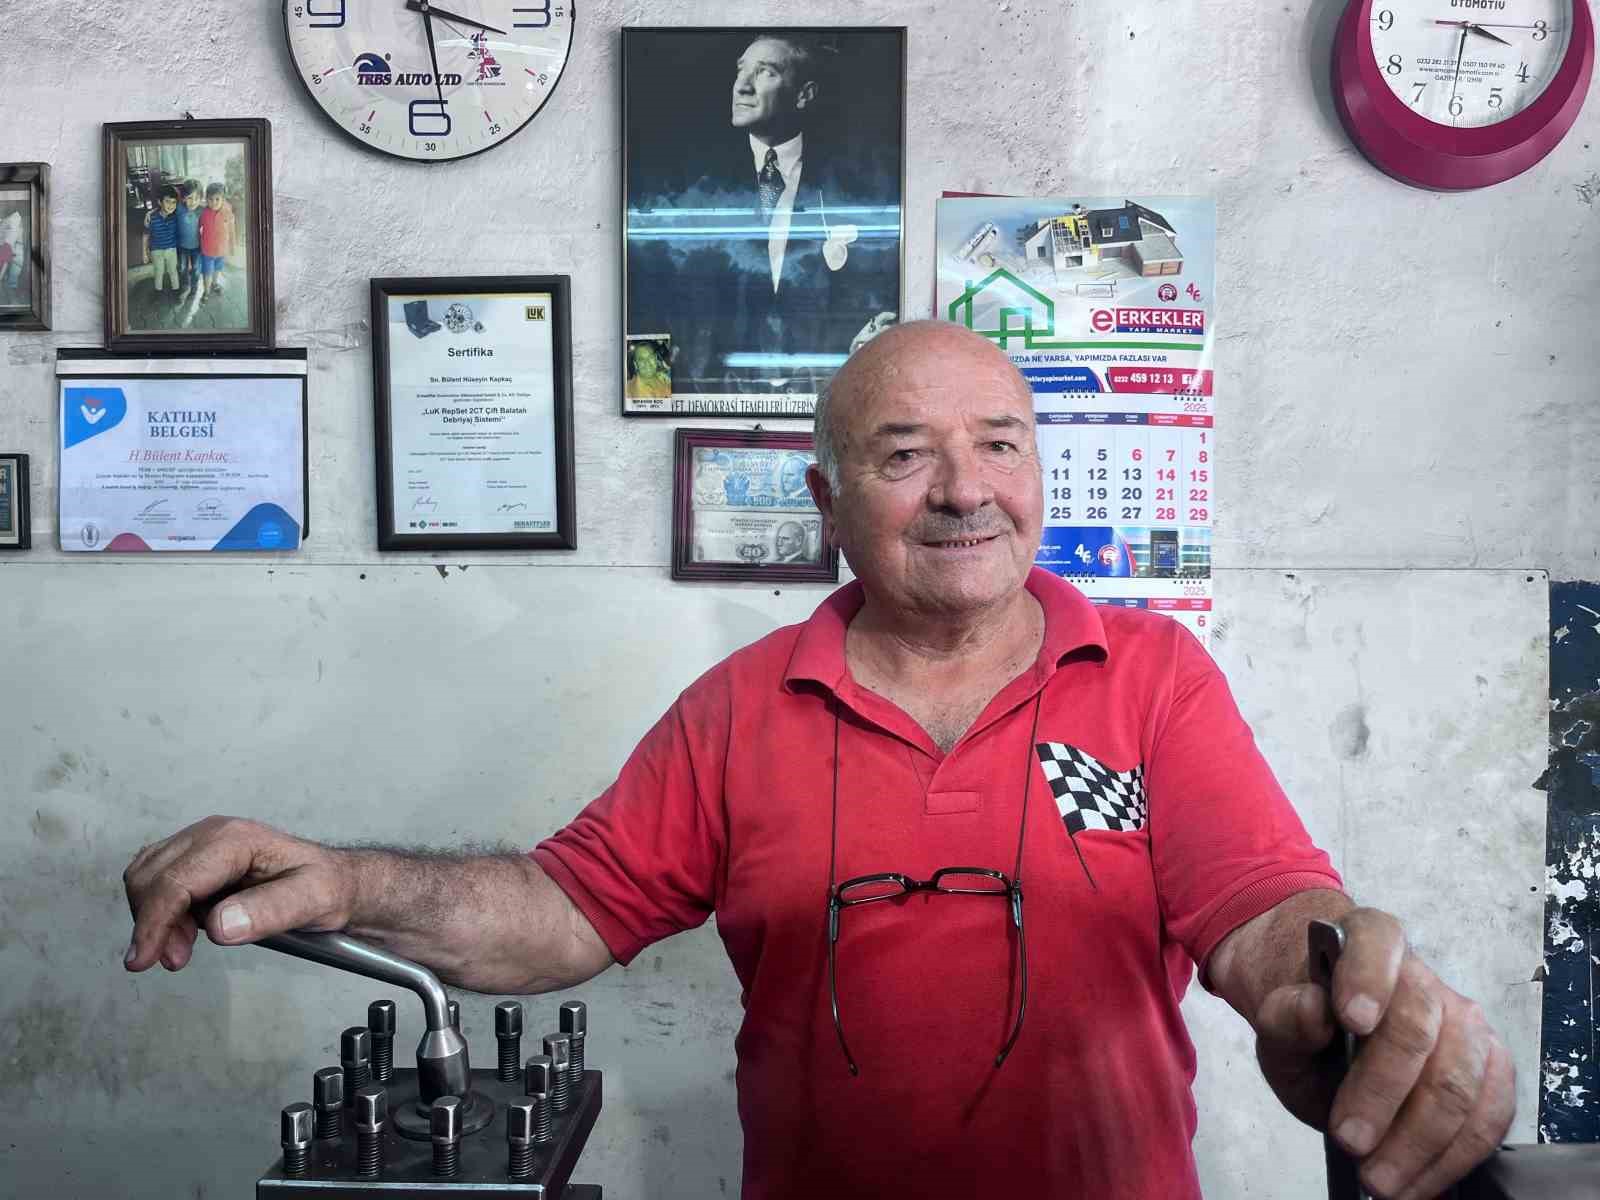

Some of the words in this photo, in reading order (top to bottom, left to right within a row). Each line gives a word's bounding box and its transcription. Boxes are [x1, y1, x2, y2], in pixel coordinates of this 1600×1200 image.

[1378, 9, 1394, 32] 9
[1532, 19, 1547, 42] 3
[1385, 54, 1403, 76] 8
[1514, 61, 1530, 84] 4
[311, 73, 323, 86] 40
[394, 74, 433, 86] AUTO
[435, 74, 462, 86] LTD
[536, 73, 549, 86] 20
[1411, 82, 1428, 104] 7
[1487, 87, 1504, 109] 5
[1448, 94, 1464, 118] 6
[409, 99, 452, 136] 6
[359, 123, 371, 135] 35
[488, 123, 501, 136] 25
[424, 142, 437, 152] 30
[1119, 310, 1202, 327] ERKEKLER
[447, 347, 494, 358] Sertifika
[1031, 355, 1042, 363] NE
[1043, 354, 1073, 364] VARSA,
[1074, 354, 1118, 363] YAPIMIZDA
[1119, 354, 1150, 363] FAZLASI
[1151, 354, 1167, 363] VAR
[441, 376, 462, 384] Bülent
[1130, 373, 1148, 383] 459
[1149, 373, 1161, 384] 12
[1162, 373, 1174, 384] 13
[468, 407, 484, 415] 2CT
[688, 397, 738, 412] DEMOKRASİ
[739, 397, 783, 412] TEMELLERİ
[1183, 402, 1208, 413] 2025
[147, 410, 217, 423] KATILIM
[149, 423, 215, 438] BELGESİ
[1199, 432, 1207, 444] 1
[1061, 448, 1072, 461] 4
[1096, 448, 1108, 461] 5
[1131, 448, 1142, 461] 6
[1165, 449, 1176, 461] 7
[1199, 451, 1208, 463] 8
[1050, 468, 1071, 480] 11
[1086, 468, 1108, 480] 12
[1121, 468, 1142, 480] 13
[1156, 469, 1176, 481] 14
[1189, 470, 1208, 482] 15
[1050, 487, 1072, 500] 18
[1086, 487, 1108, 500] 19
[1121, 488, 1142, 500] 20
[1155, 488, 1175, 501] 21
[1189, 489, 1208, 502] 22
[1050, 507, 1072, 520] 25
[1086, 507, 1108, 520] 26
[1121, 507, 1142, 520] 27
[1155, 508, 1176, 520] 28
[1189, 508, 1208, 521] 29
[1183, 586, 1207, 596] 2025
[1197, 615, 1206, 627] 6
